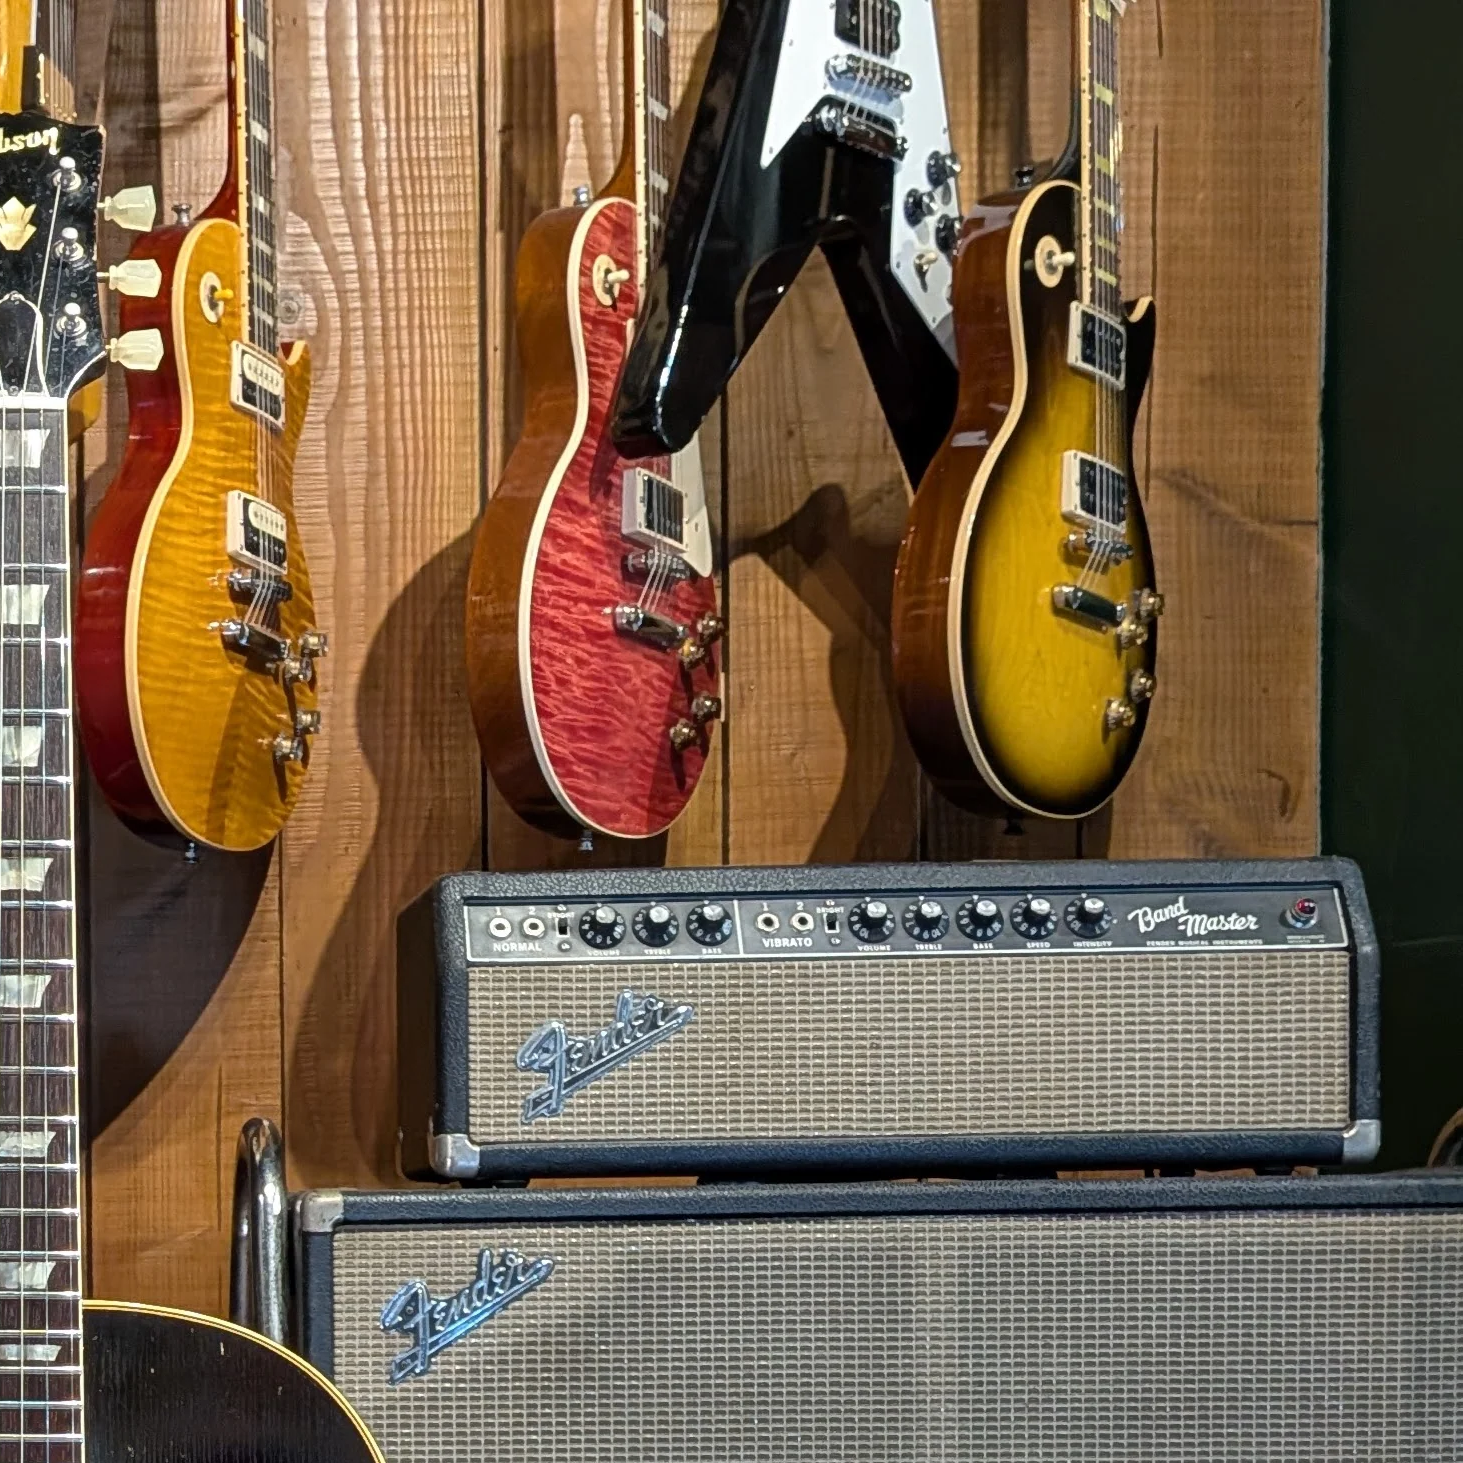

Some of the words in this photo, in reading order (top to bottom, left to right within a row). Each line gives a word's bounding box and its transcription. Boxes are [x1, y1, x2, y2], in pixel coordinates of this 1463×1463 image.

[495, 907, 502, 915] 1
[528, 906, 536, 915] 2
[763, 903, 769, 911] 1
[796, 902, 804, 911] 2
[1127, 896, 1189, 934] Band
[1178, 912, 1260, 937] Master
[493, 942, 543, 952] NORMAL
[762, 937, 813, 948] VIBRATO
[515, 988, 695, 1124] Fender
[380, 1248, 556, 1386] Fender
